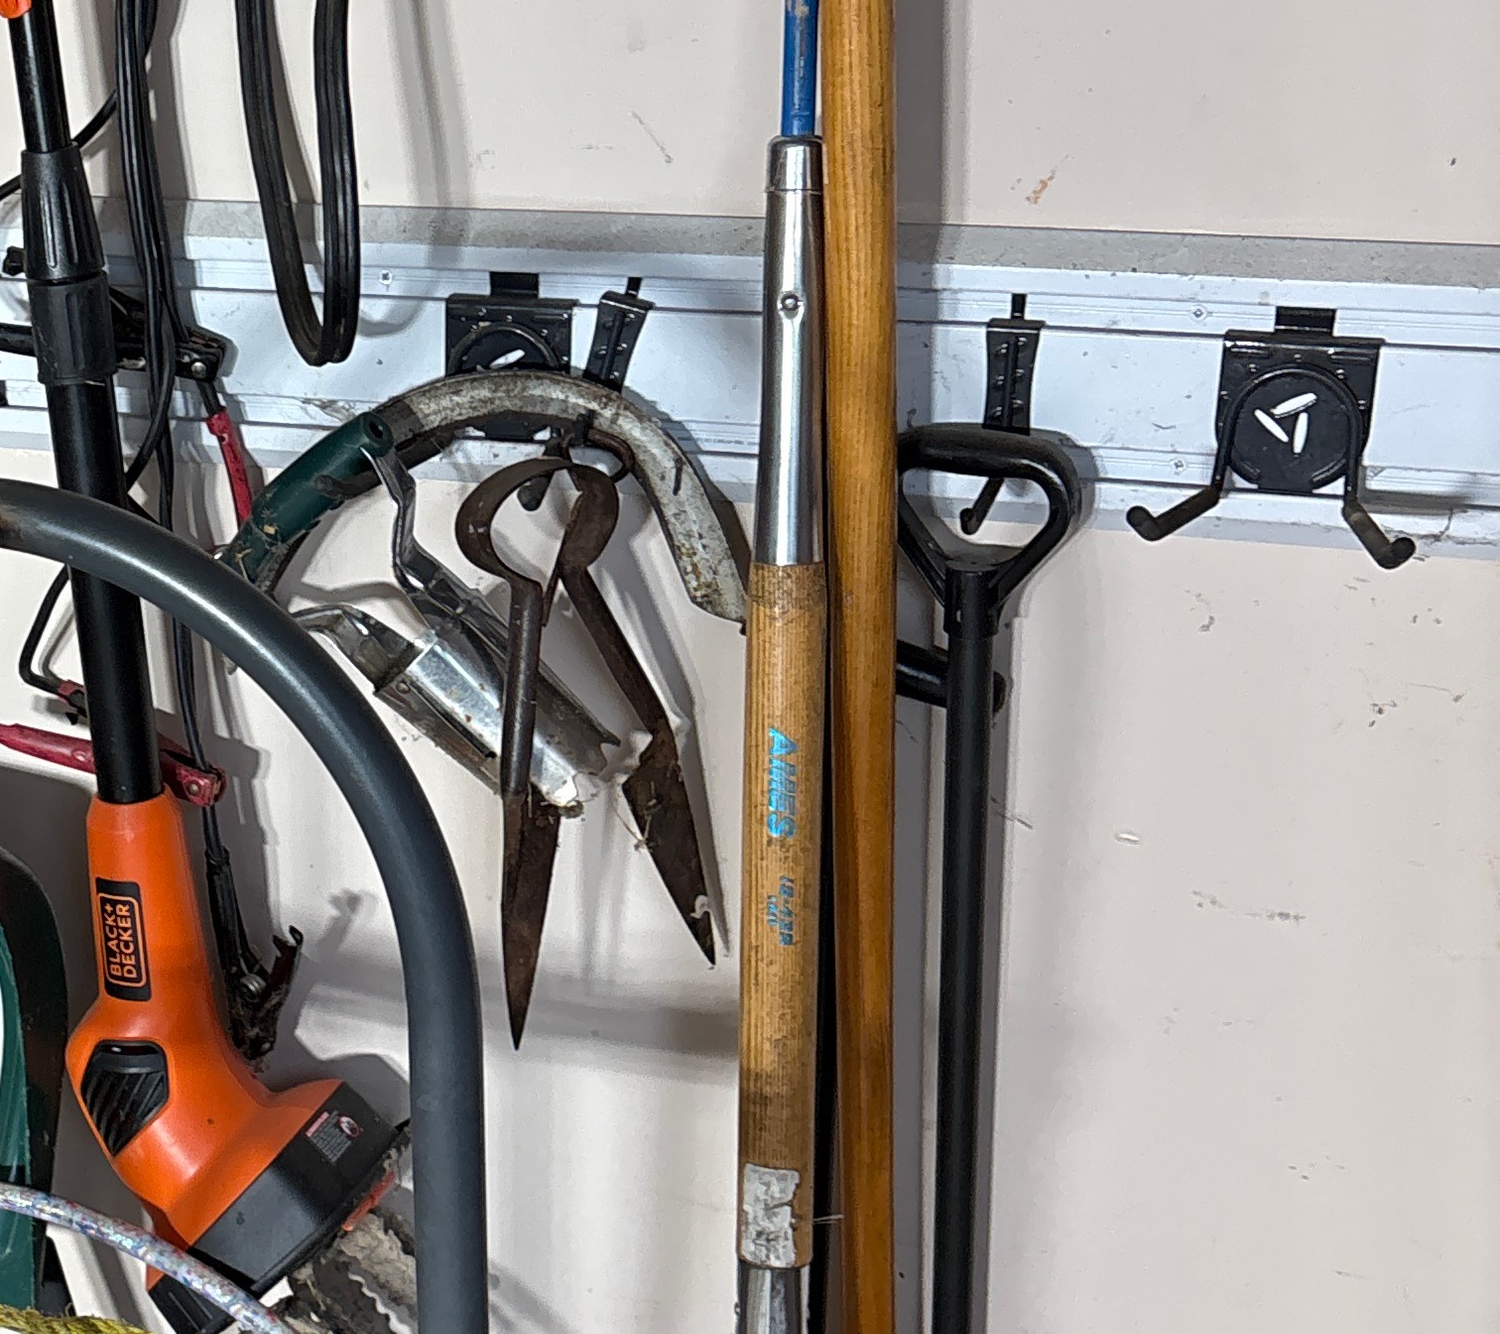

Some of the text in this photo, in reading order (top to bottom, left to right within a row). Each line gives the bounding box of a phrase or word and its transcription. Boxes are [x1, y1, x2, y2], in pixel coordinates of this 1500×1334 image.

[767, 726, 798, 839] AMES
[104, 903, 122, 977] BLACK+
[115, 903, 137, 979] DECKER
